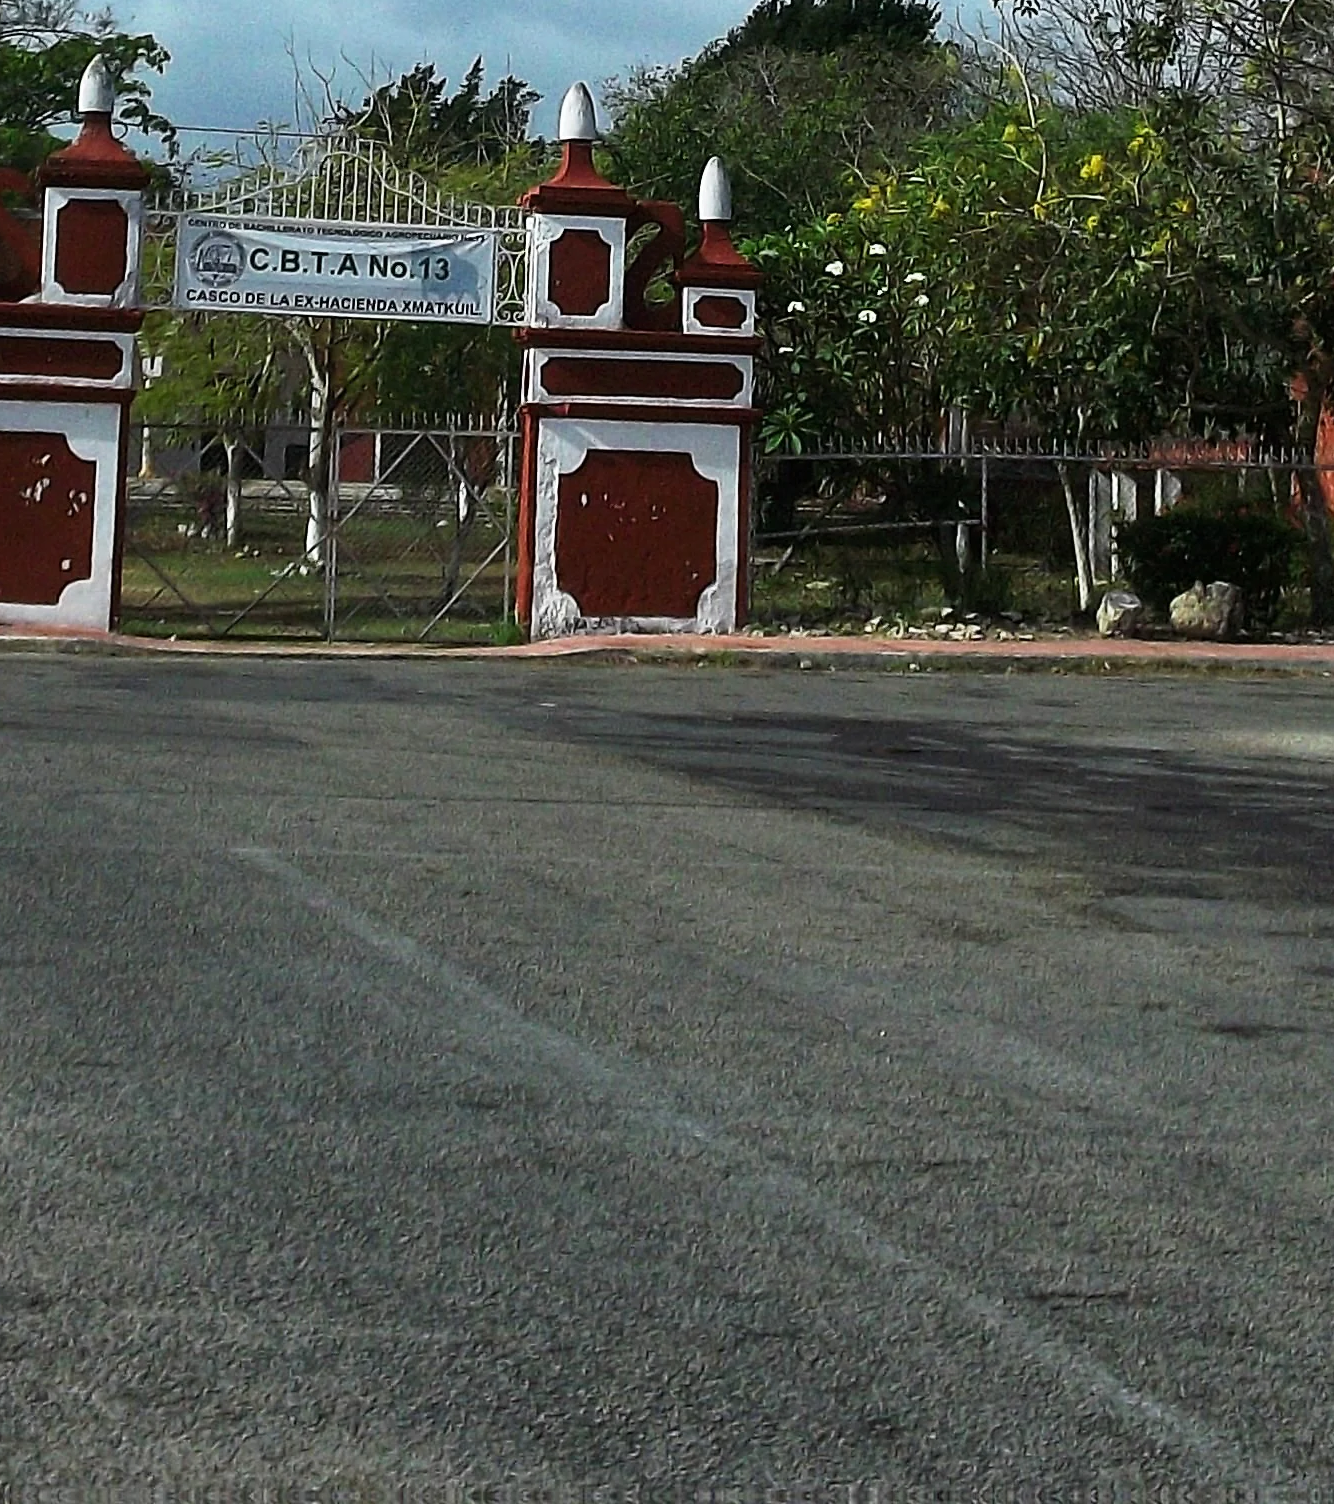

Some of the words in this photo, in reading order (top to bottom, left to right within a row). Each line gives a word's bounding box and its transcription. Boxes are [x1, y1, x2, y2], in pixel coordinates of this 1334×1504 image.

[188, 218, 227, 229] CENTRO
[228, 221, 242, 230] DE
[243, 223, 315, 234] BACHILLERATO
[317, 227, 383, 238] TECNOLOGICO
[249, 248, 359, 277] C.B.T.A
[186, 289, 241, 304] CASCO
[245, 292, 266, 305] DE
[270, 294, 290, 307] LA
[294, 295, 398, 312] EX-HACIENDA
